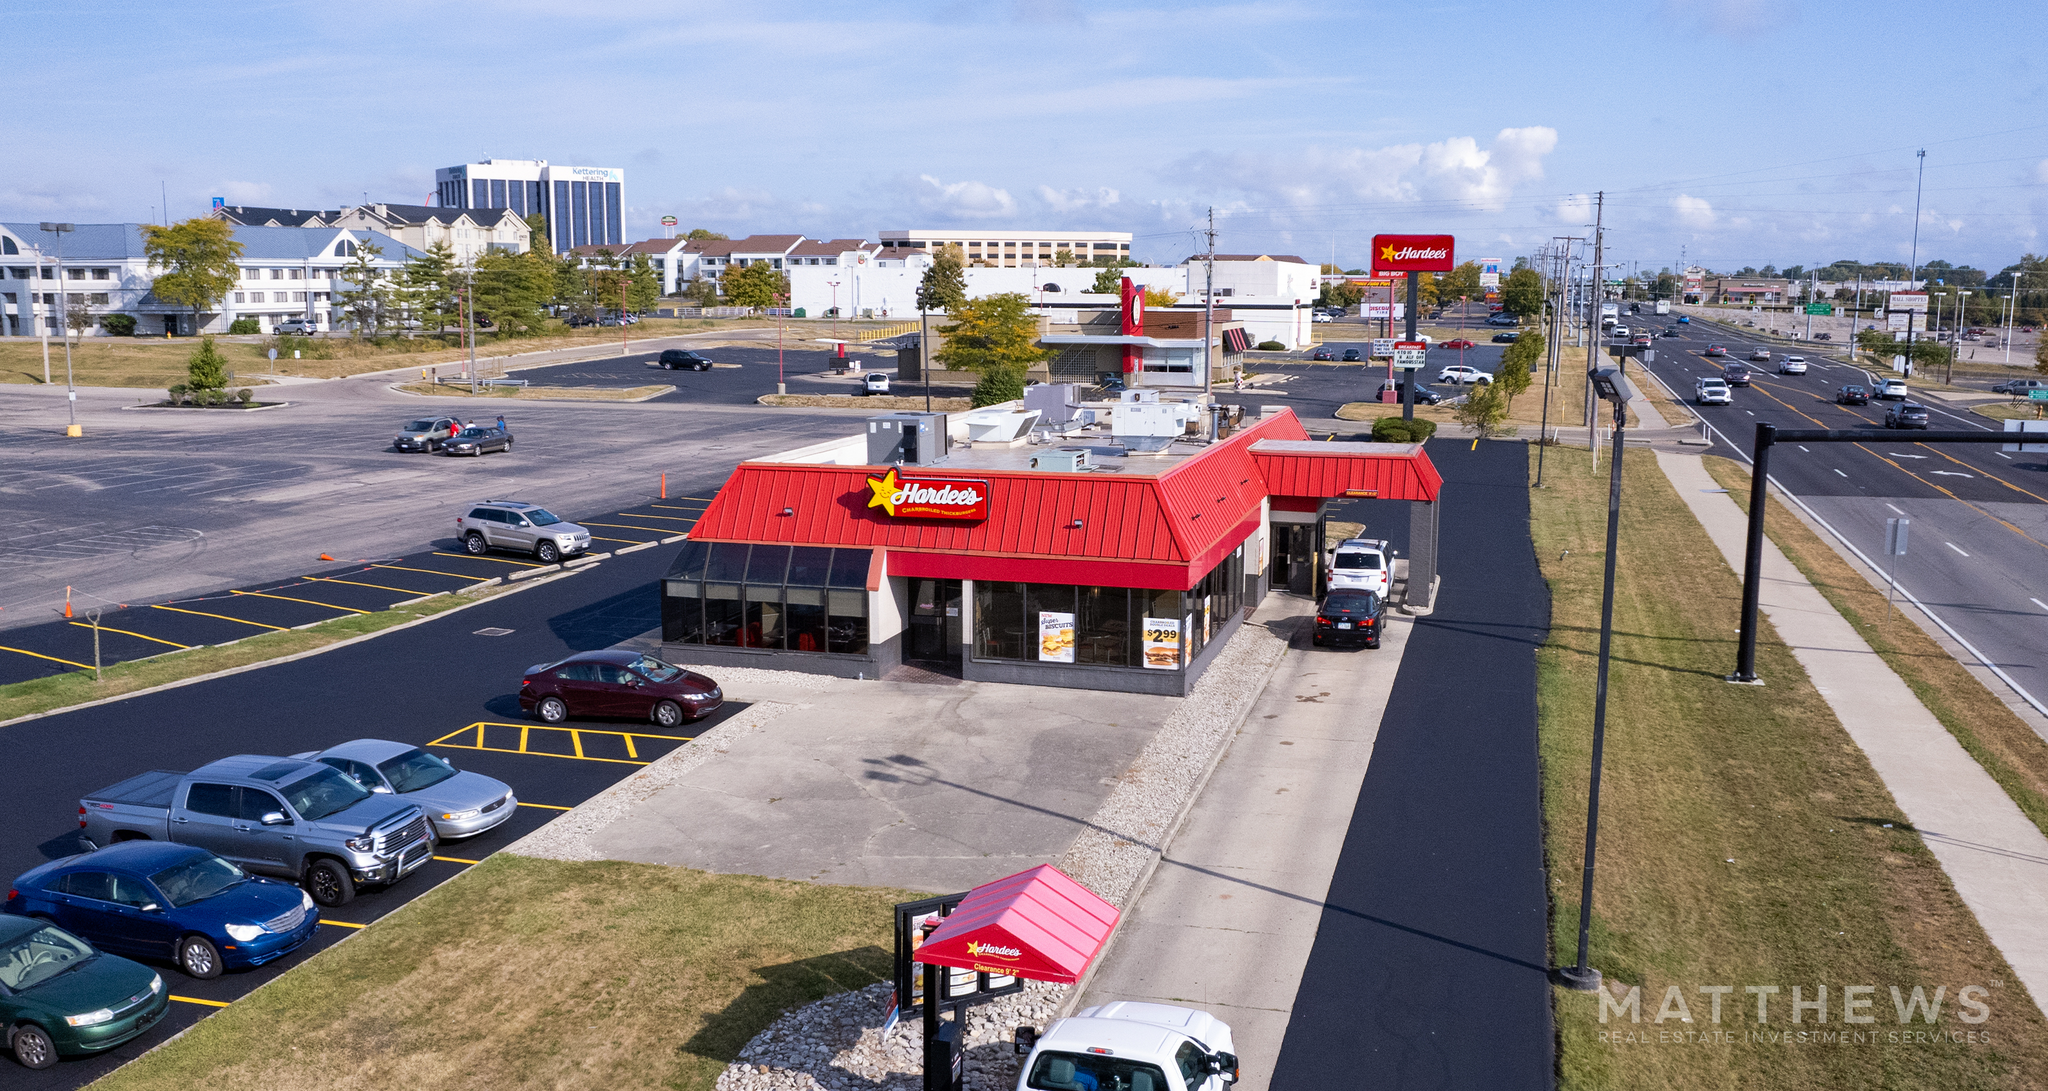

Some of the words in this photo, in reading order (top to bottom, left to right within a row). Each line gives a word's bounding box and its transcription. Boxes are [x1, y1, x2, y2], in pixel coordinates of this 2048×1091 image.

[572, 167, 608, 177] Kettering
[1394, 247, 1447, 260] Hardee's
[890, 483, 983, 505] Hardee's
[902, 506, 940, 514] CHARBROILED
[941, 508, 976, 516] THICKBURGERS
[1045, 621, 1074, 629] BISCUITS
[976, 943, 1022, 956] Hardee's
[974, 963, 1005, 974] Clearance
